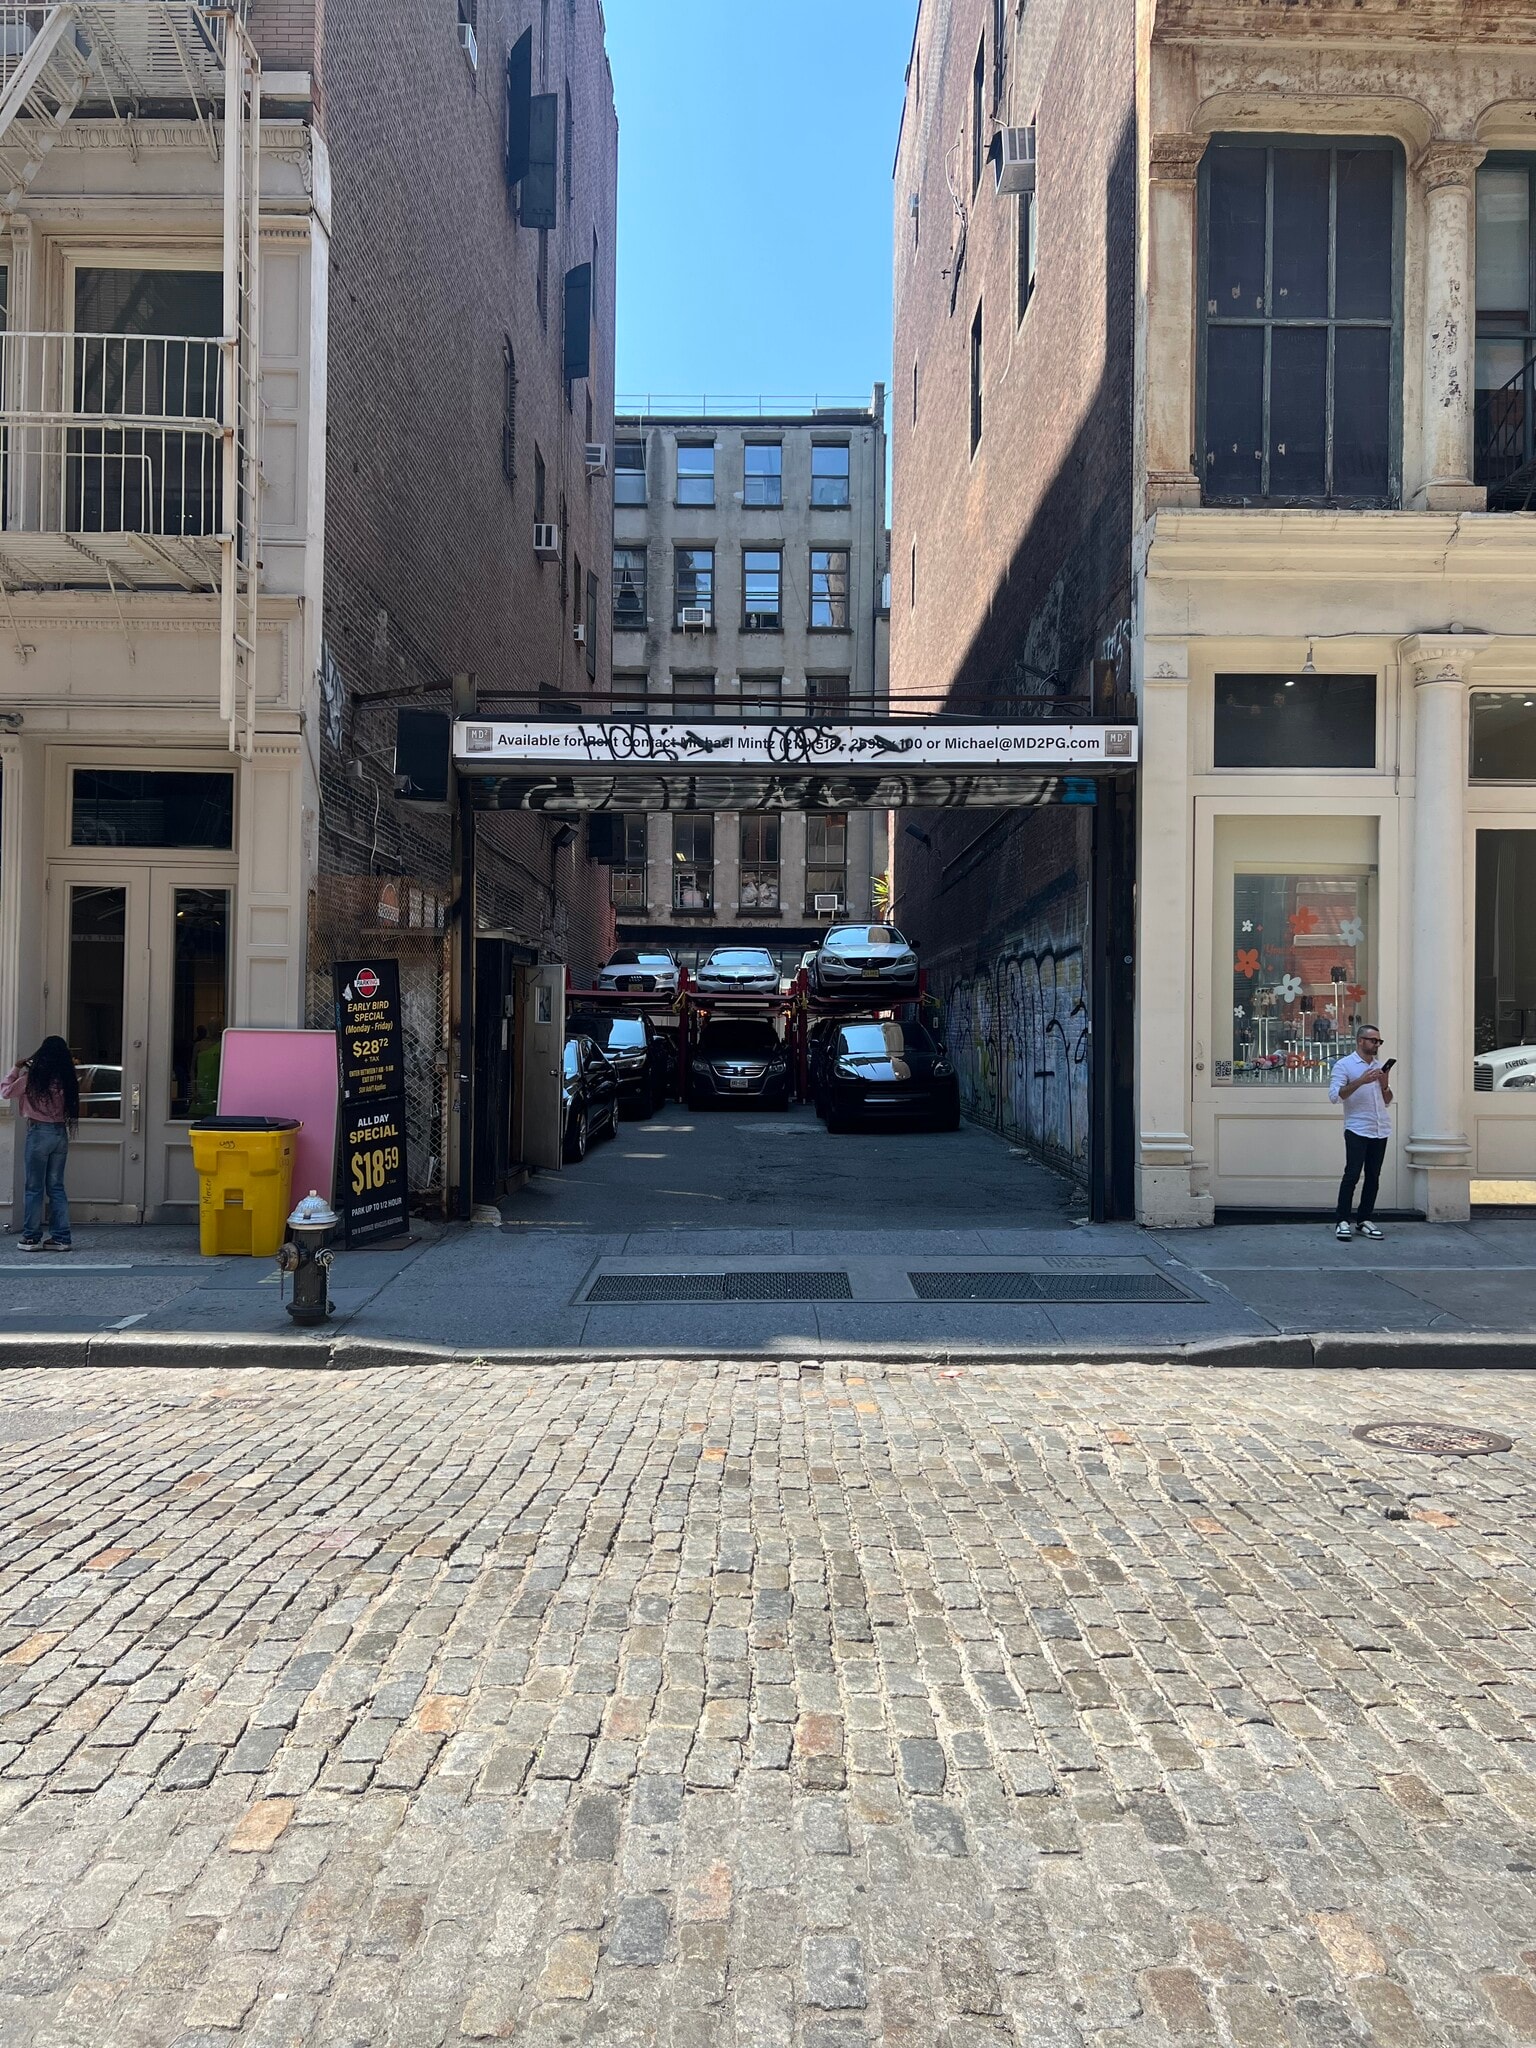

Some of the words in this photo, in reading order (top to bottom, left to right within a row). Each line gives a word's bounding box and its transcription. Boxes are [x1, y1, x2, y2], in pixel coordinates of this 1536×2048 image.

[497, 734, 560, 747] Available
[564, 735, 582, 747] for
[737, 737, 776, 749] Mintz
[926, 740, 941, 749] or
[945, 737, 1100, 751] Michael@MD2PG.com
[356, 979, 378, 987] PARKING
[347, 1001, 371, 1013] EARLY
[372, 1000, 389, 1010] BIRD
[354, 1011, 385, 1023] SPECIAL
[345, 1023, 371, 1036] (Monday
[375, 1020, 394, 1032] Friday)
[369, 1055, 380, 1063] TAX
[357, 1116, 372, 1128] ALL
[373, 1113, 390, 1124] DAY
[349, 1124, 399, 1144] SPECIAL
[351, 1205, 365, 1217] PARK
[365, 1204, 373, 1214] UP
[373, 1202, 381, 1212] TO
[380, 1201, 388, 1210] 1/2
[388, 1197, 403, 1208] HOUR
